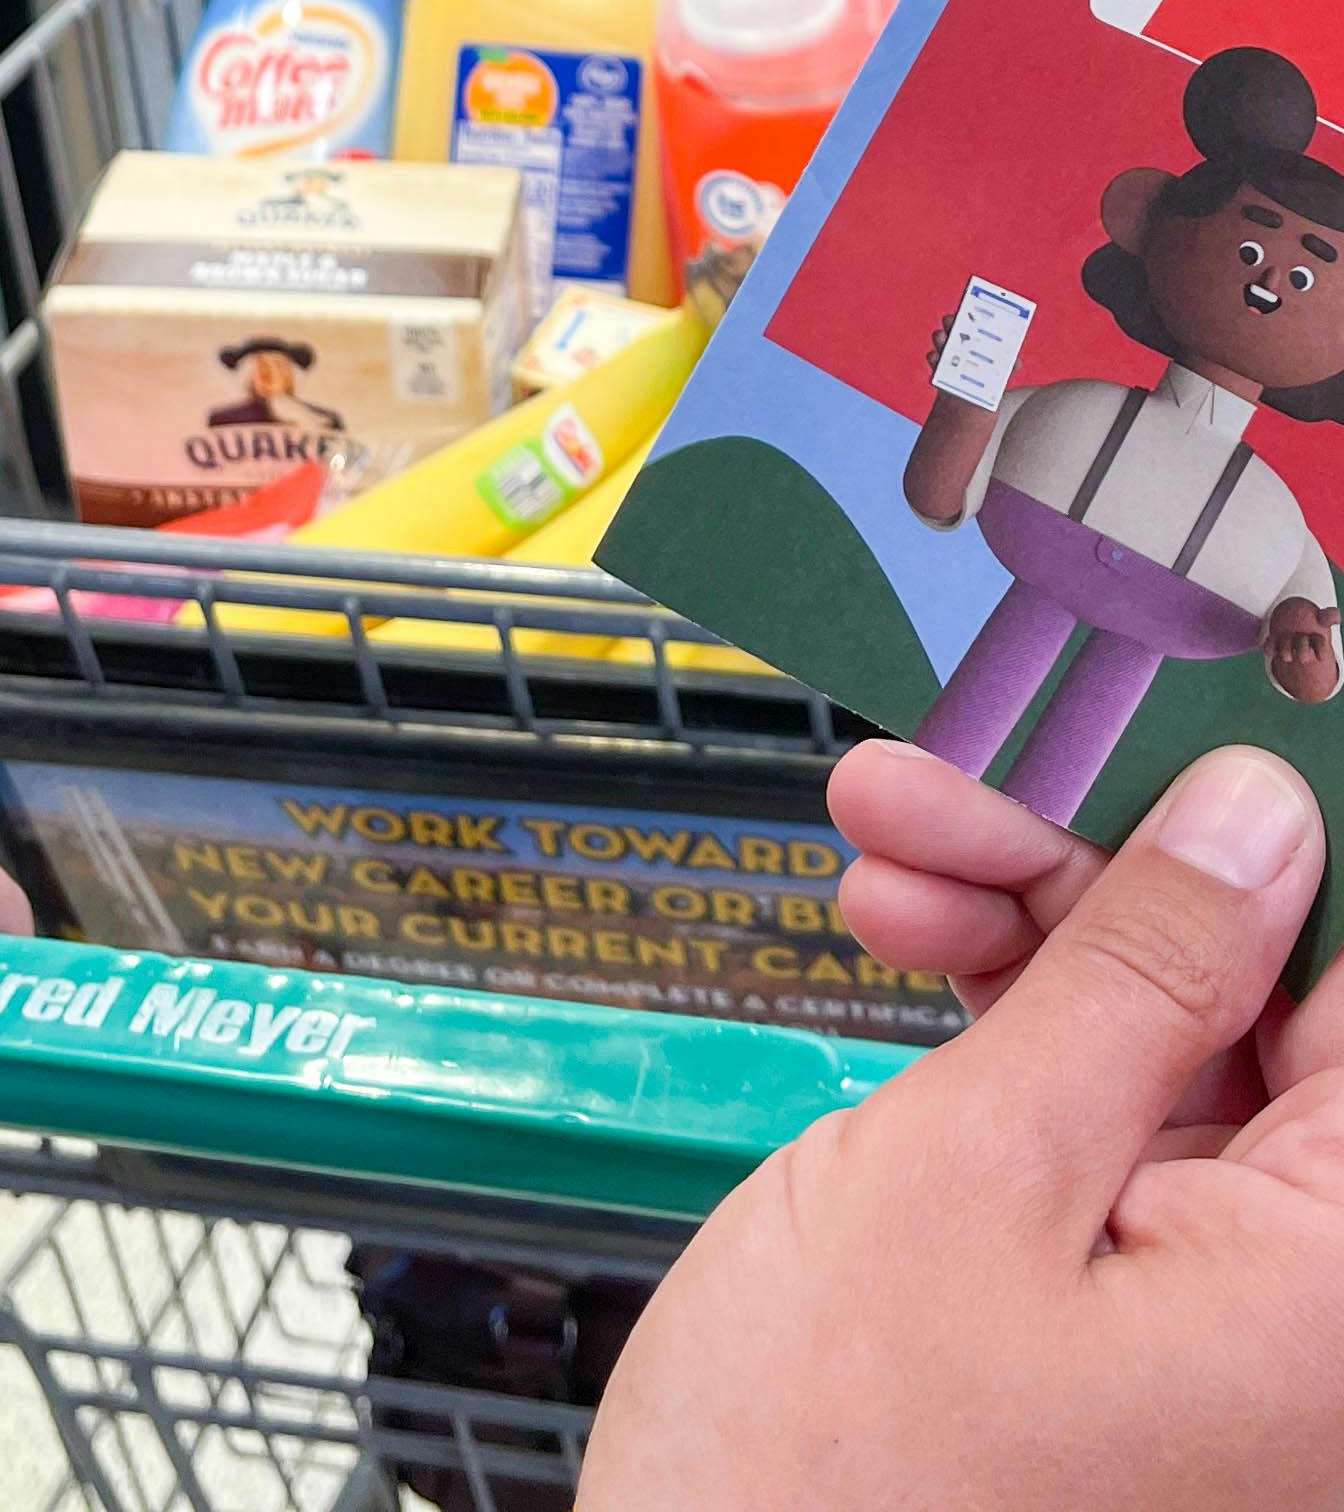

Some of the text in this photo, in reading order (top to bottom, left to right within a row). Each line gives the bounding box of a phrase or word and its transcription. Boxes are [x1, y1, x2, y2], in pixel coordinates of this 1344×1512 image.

[279, 797, 842, 879] WORK TOWARD
[173, 840, 328, 884] NEW
[352, 859, 632, 916] CAREER
[654, 887, 755, 927] OR
[187, 887, 382, 938] YOUR
[400, 912, 729, 973] CURRENT
[129, 981, 377, 1058] Meyer
[742, 992, 768, 1013] A
